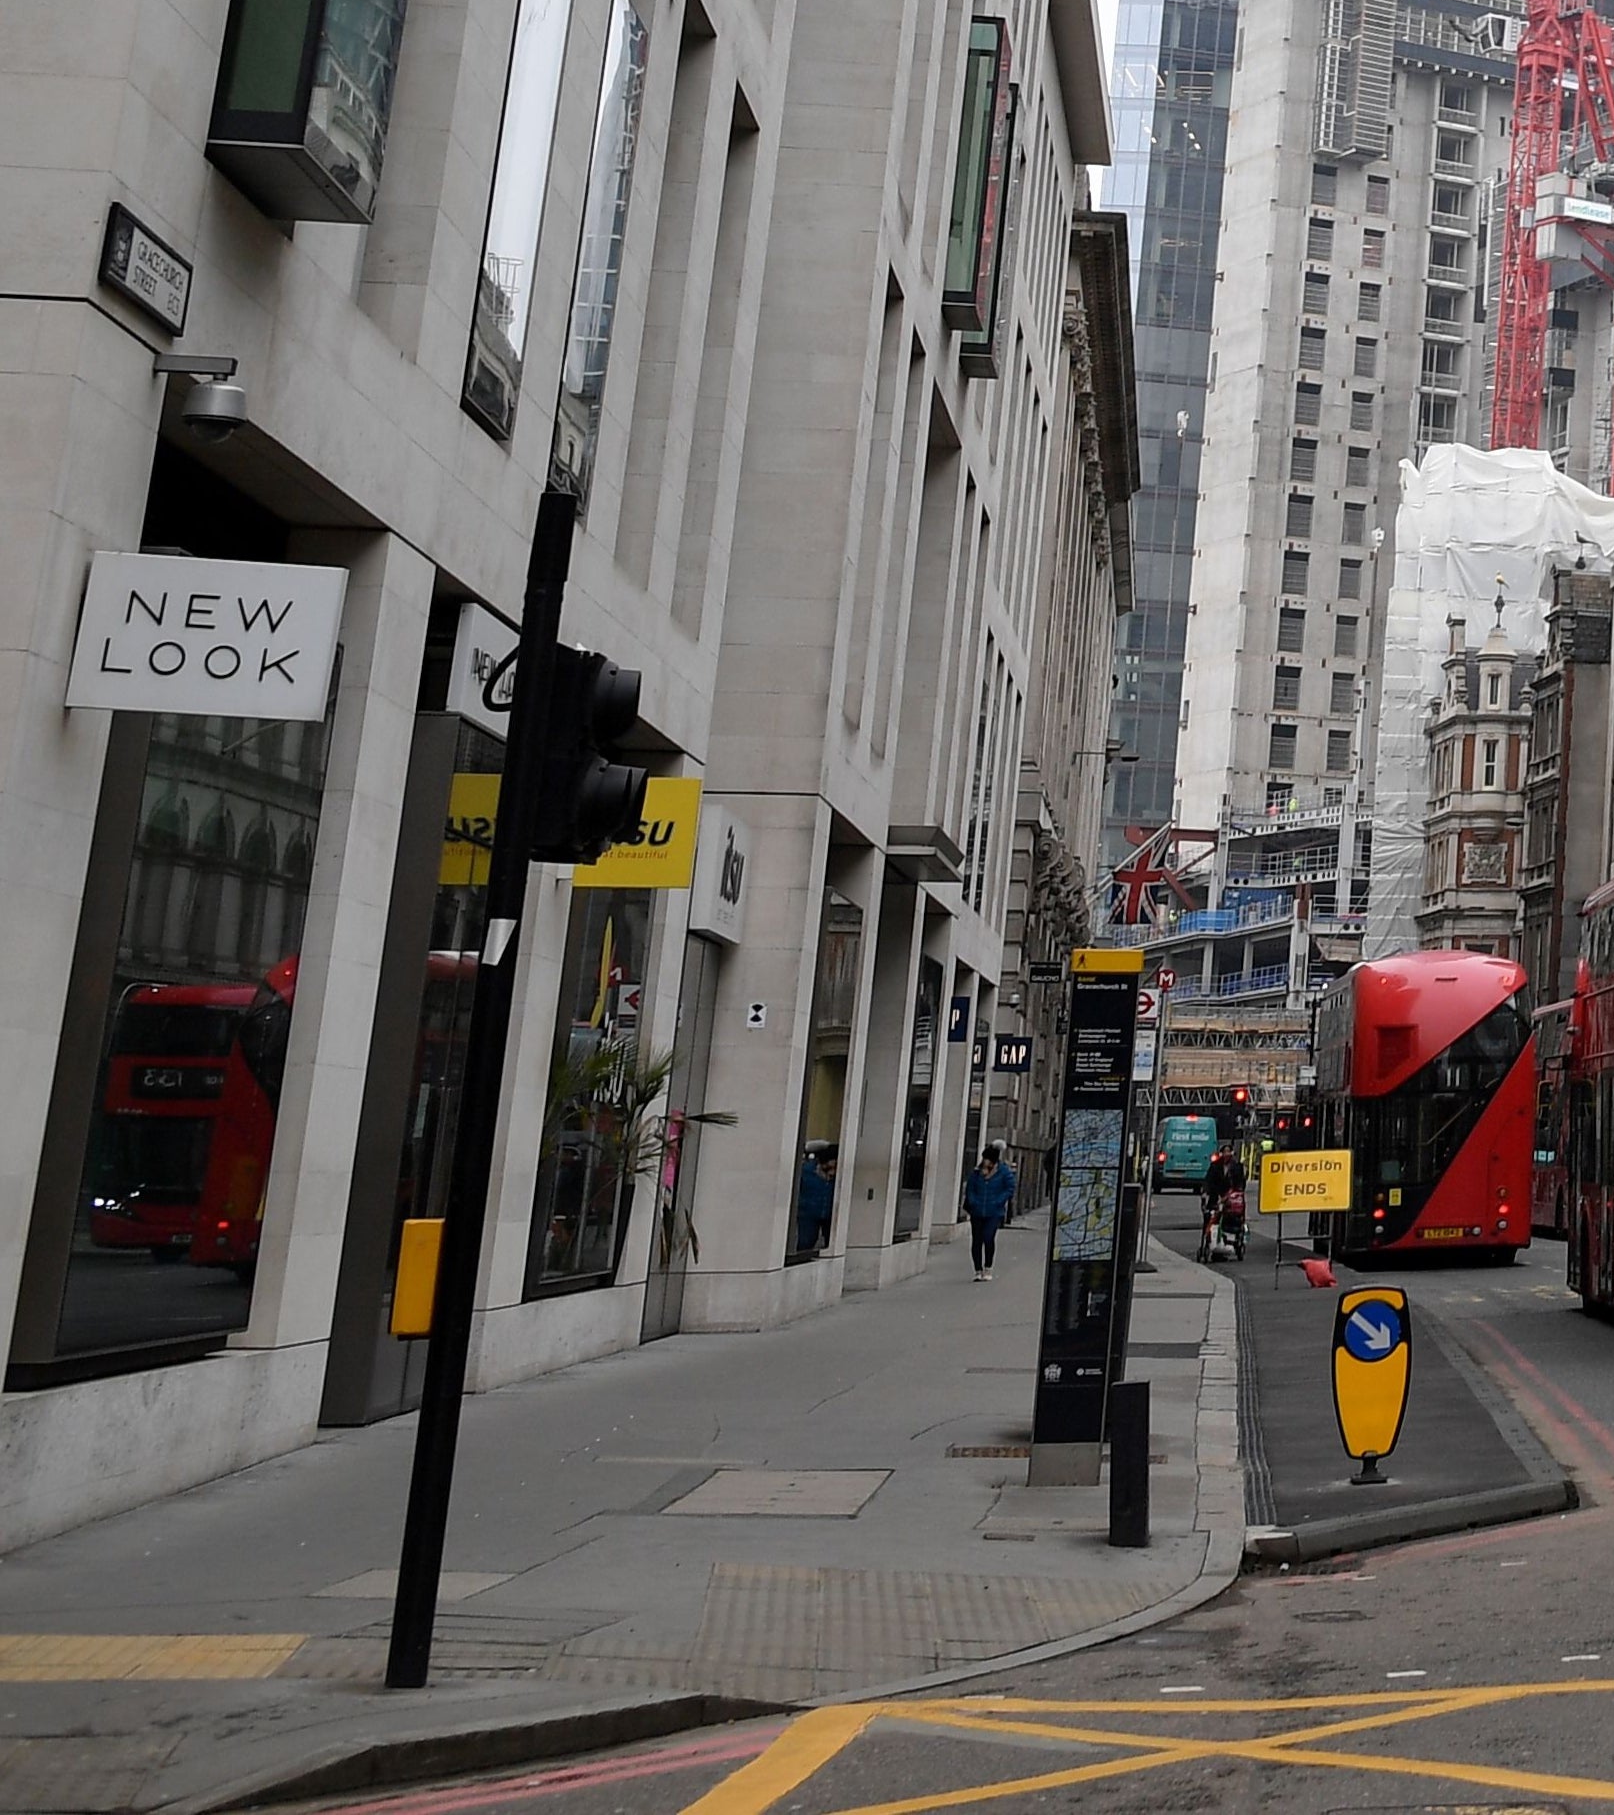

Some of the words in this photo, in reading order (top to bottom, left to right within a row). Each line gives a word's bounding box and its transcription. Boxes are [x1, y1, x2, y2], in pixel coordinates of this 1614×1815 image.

[125, 589, 293, 634] NEW
[101, 637, 300, 684] LOOK
[719, 824, 745, 906] itsu
[1160, 972, 1174, 987] M
[1000, 1045, 1027, 1065] GAP
[1270, 1158, 1343, 1174] Diversion
[1283, 1183, 1328, 1196] ENDS
